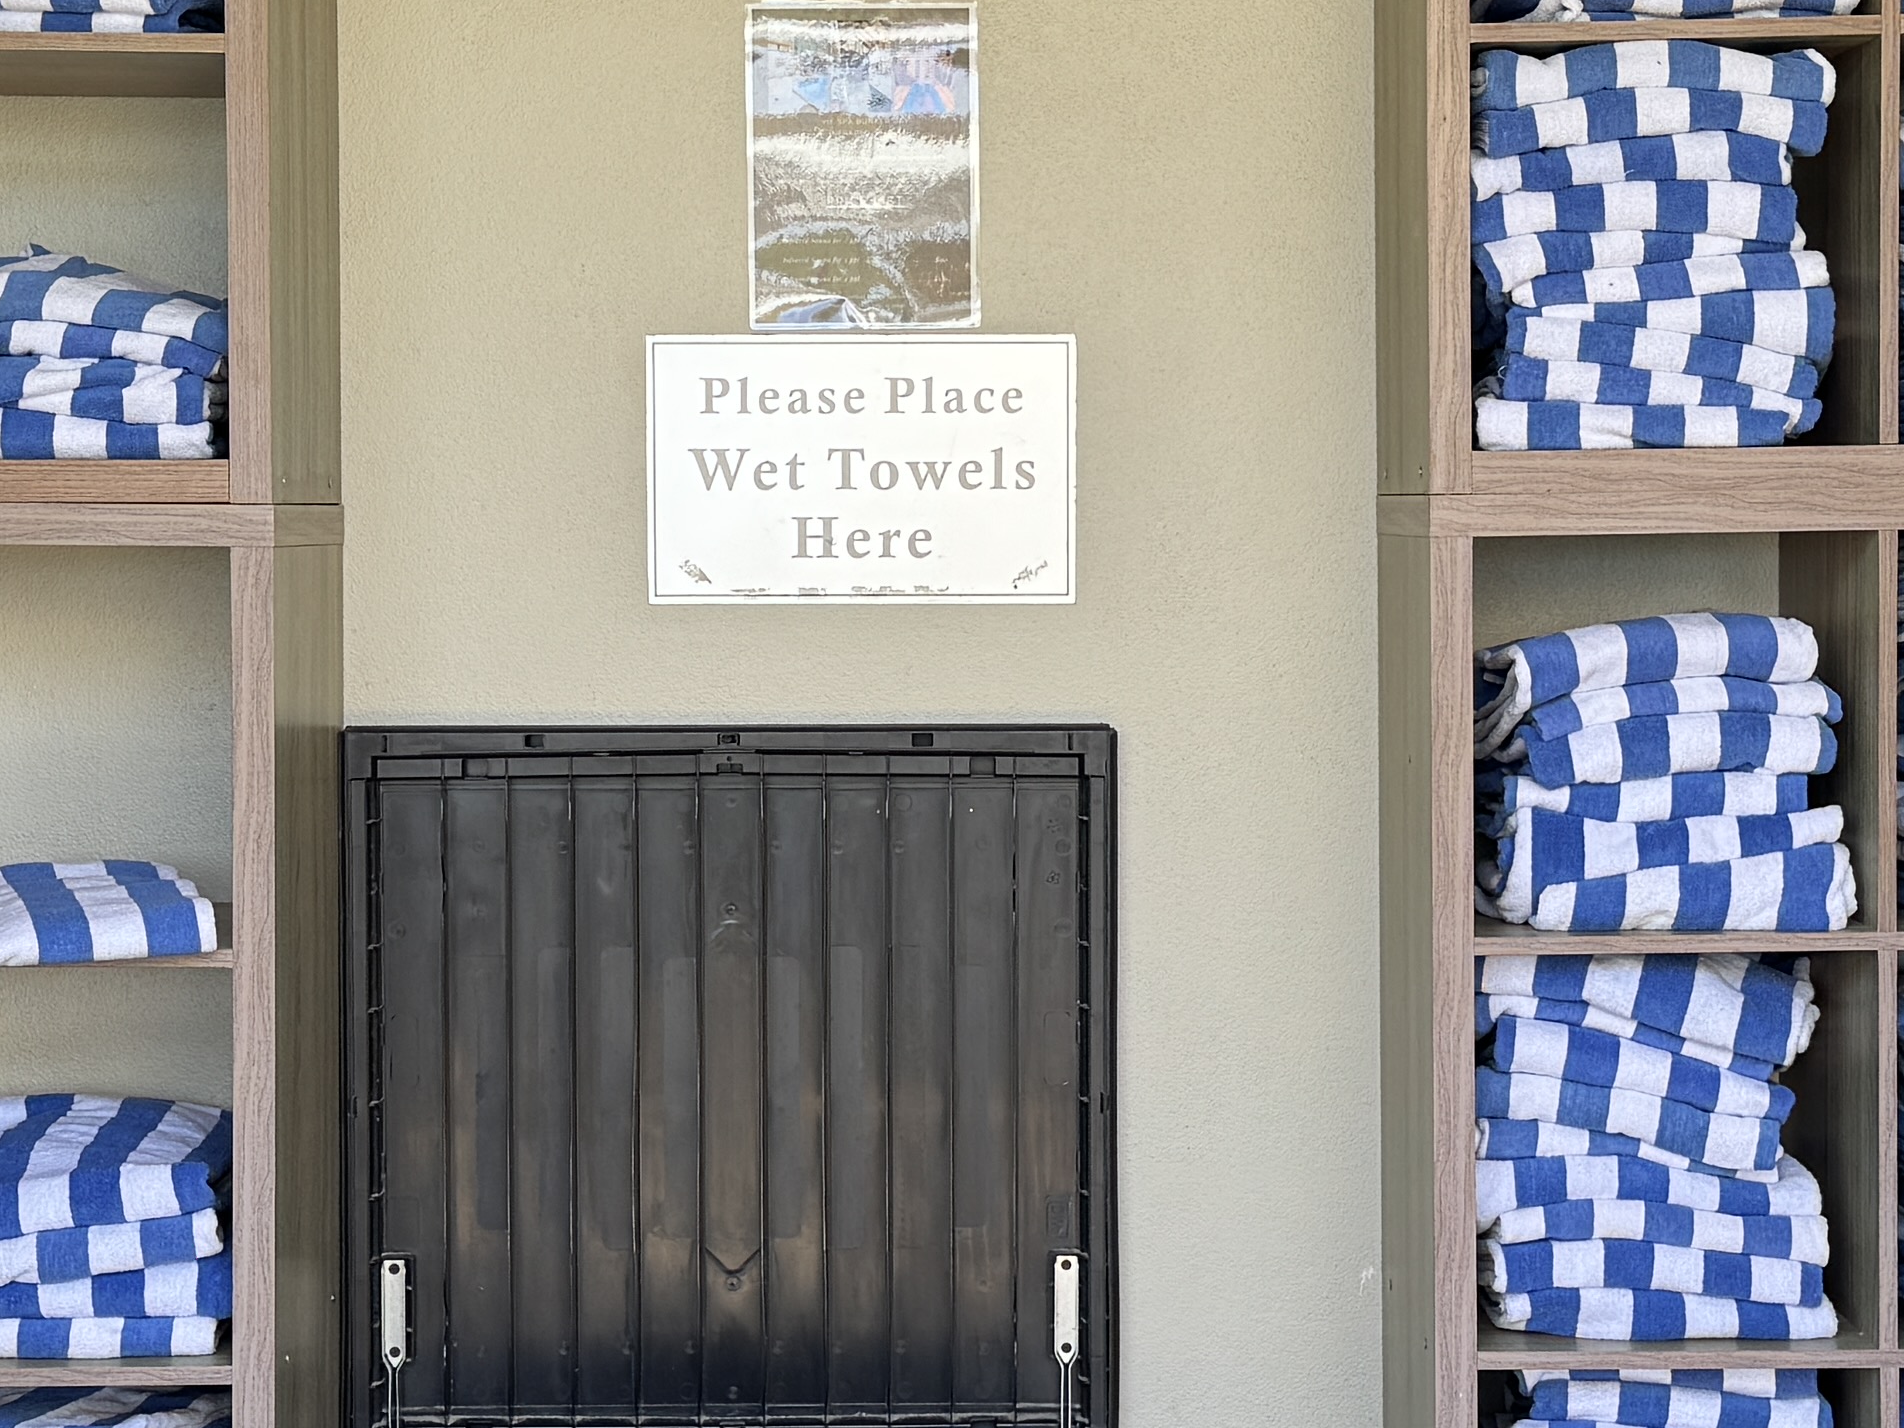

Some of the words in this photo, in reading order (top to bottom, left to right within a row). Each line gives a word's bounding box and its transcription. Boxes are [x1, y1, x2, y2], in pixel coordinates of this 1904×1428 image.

[699, 376, 866, 415] Please
[884, 376, 1024, 415] Place
[688, 448, 806, 492] Wet
[827, 447, 1037, 491] Towels
[791, 516, 933, 559] Here
